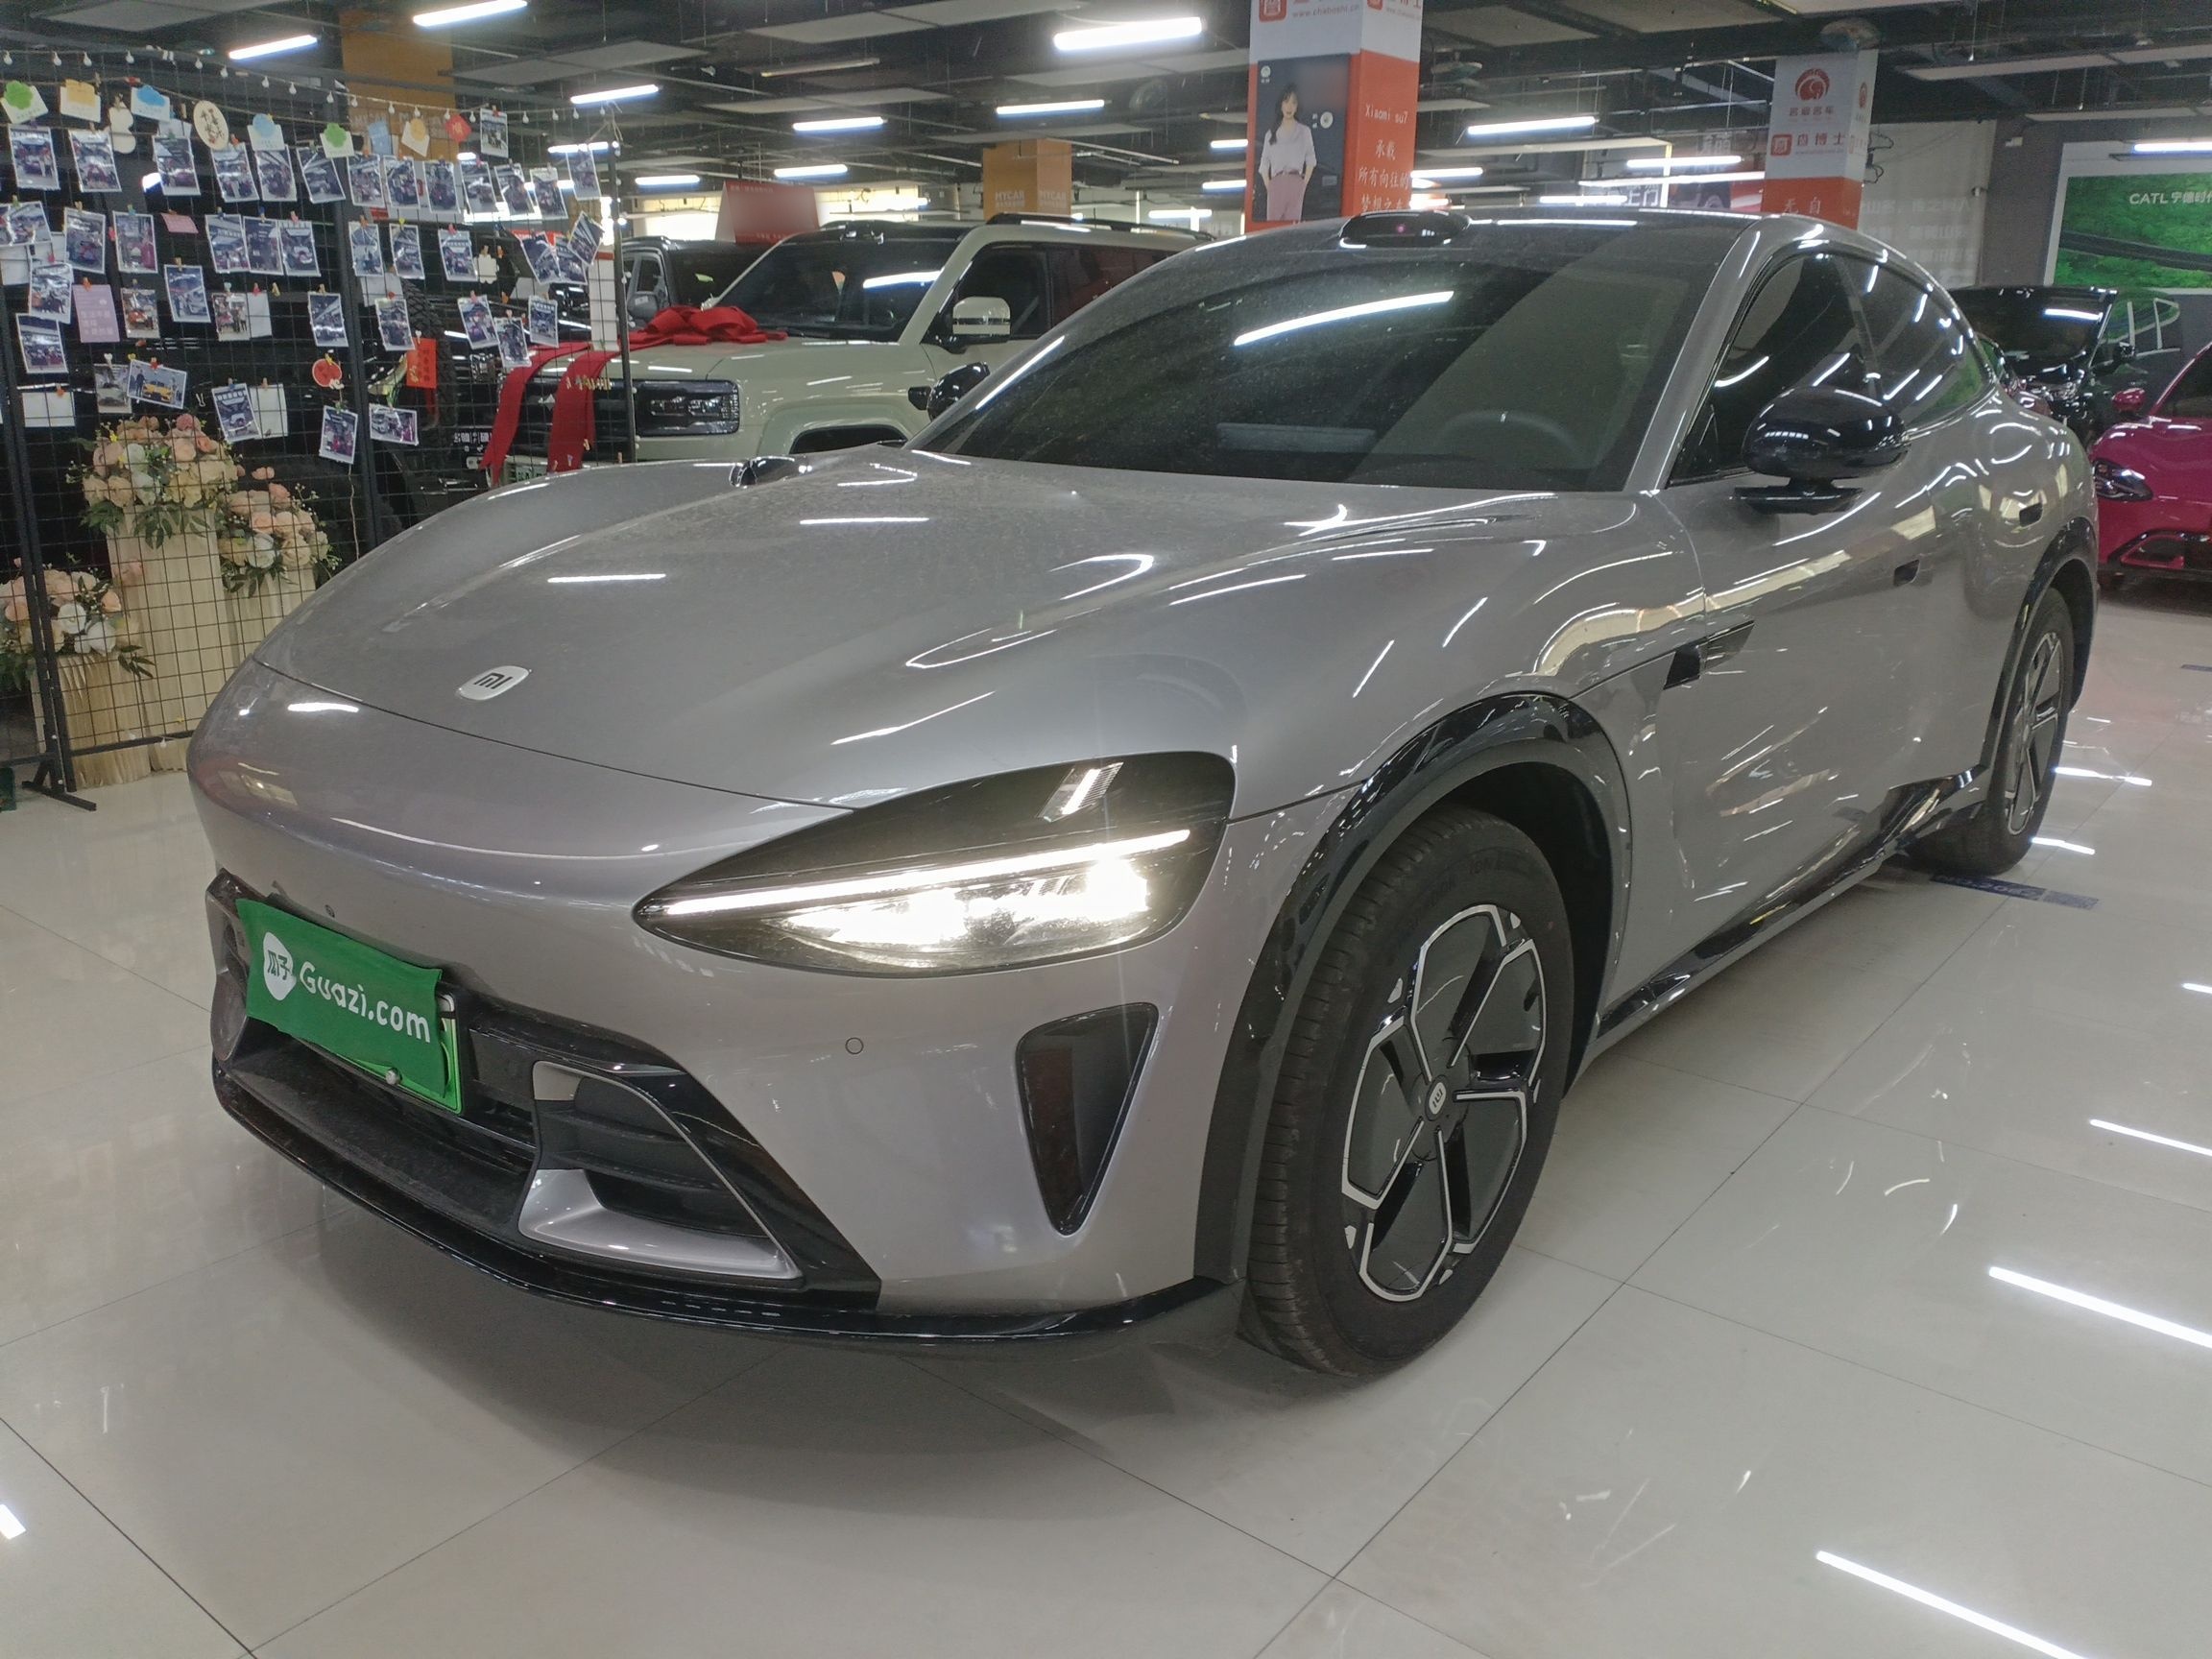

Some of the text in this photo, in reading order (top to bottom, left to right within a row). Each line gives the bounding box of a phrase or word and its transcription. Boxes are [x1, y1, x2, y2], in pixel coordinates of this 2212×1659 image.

[1358, 166, 1409, 190] 所有向往的
[2129, 193, 2168, 204] CATL
[267, 950, 293, 981] 瓜子
[299, 961, 431, 1044] Guazi.com
